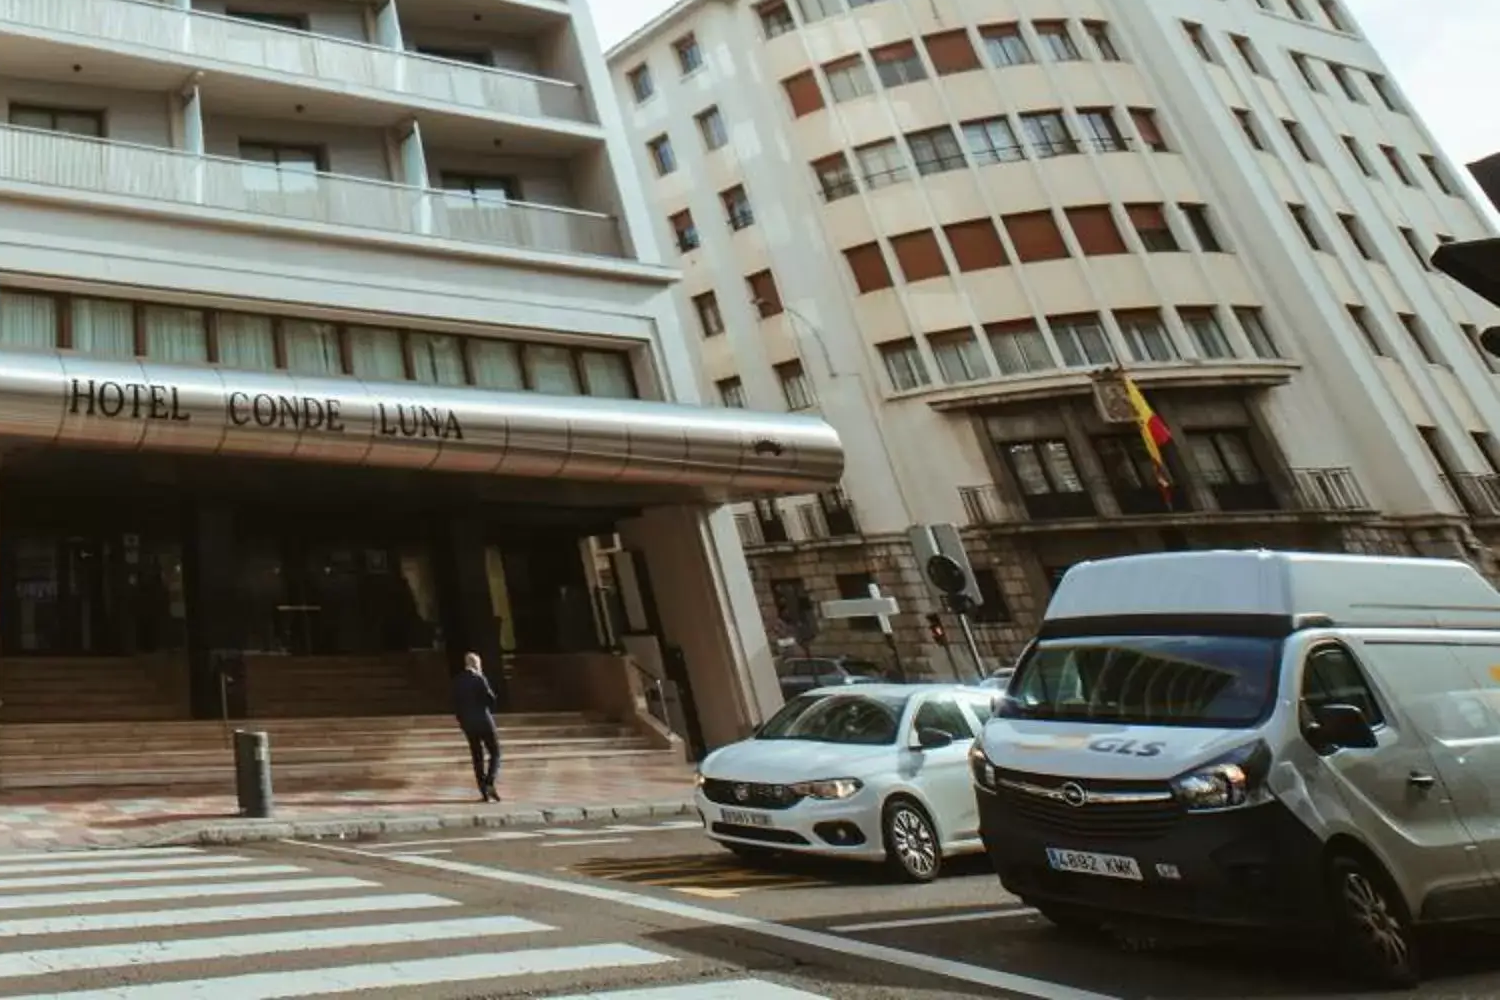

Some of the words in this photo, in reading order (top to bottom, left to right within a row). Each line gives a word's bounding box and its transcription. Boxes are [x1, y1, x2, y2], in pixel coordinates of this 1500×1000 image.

[69, 378, 191, 422] HOTEL
[228, 391, 344, 432] CONDE
[377, 402, 464, 440] LUNA
[1088, 738, 1167, 757] GLS
